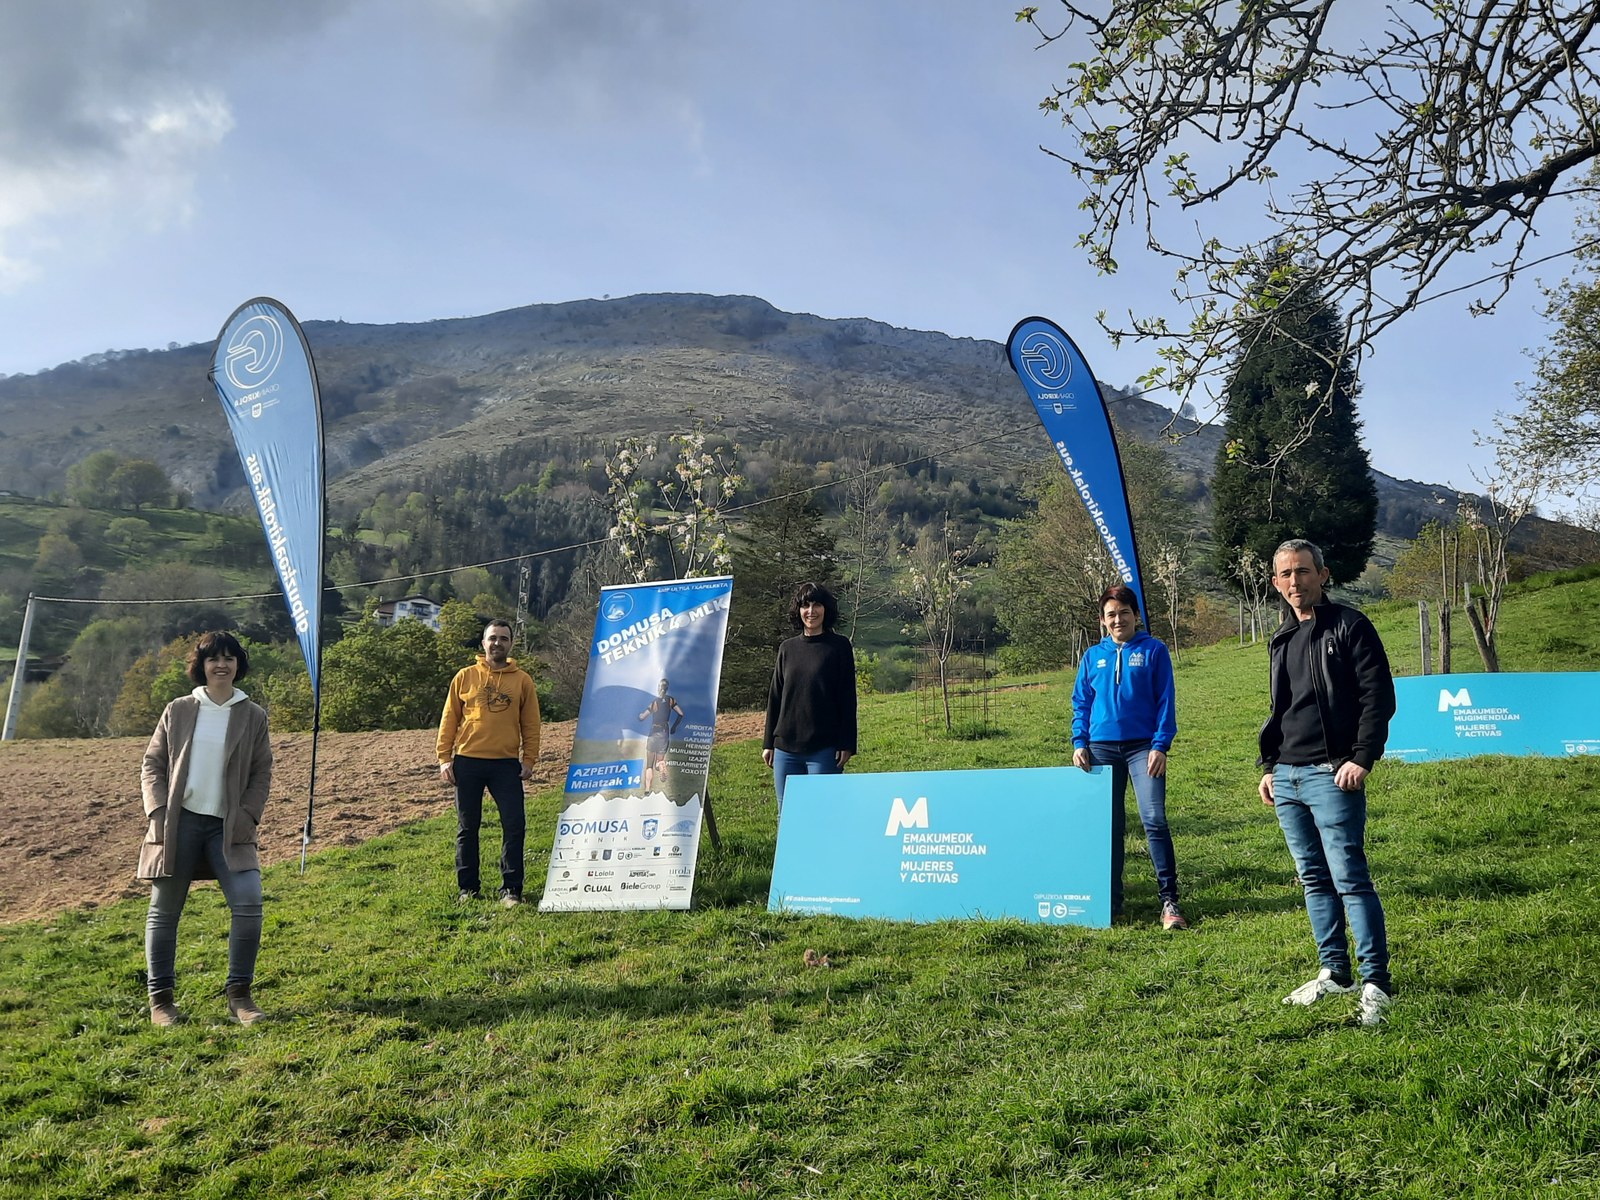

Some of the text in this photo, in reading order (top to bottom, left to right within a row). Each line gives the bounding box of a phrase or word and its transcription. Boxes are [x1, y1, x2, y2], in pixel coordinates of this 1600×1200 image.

[596, 607, 674, 654] DOMUSA
[601, 623, 667, 665] TEKNIK
[689, 597, 729, 622] MLK
[1453, 708, 1509, 716] EMAKUMEOK
[1454, 714, 1520, 722] MUGIMENDUAN
[670, 748, 710, 756] MURUMENDI
[572, 764, 629, 777] AZPEITIA
[570, 775, 641, 790] Maiatzak 14
[884, 797, 929, 836] M
[560, 820, 629, 836] DOMUSA
[903, 833, 974, 844] EMAKUMEOK
[902, 845, 987, 855] MUGIMENDUAN
[900, 861, 954, 871] MUJERES
[900, 872, 959, 884] Y ACTIVAS
[584, 884, 613, 893] GLUAL
